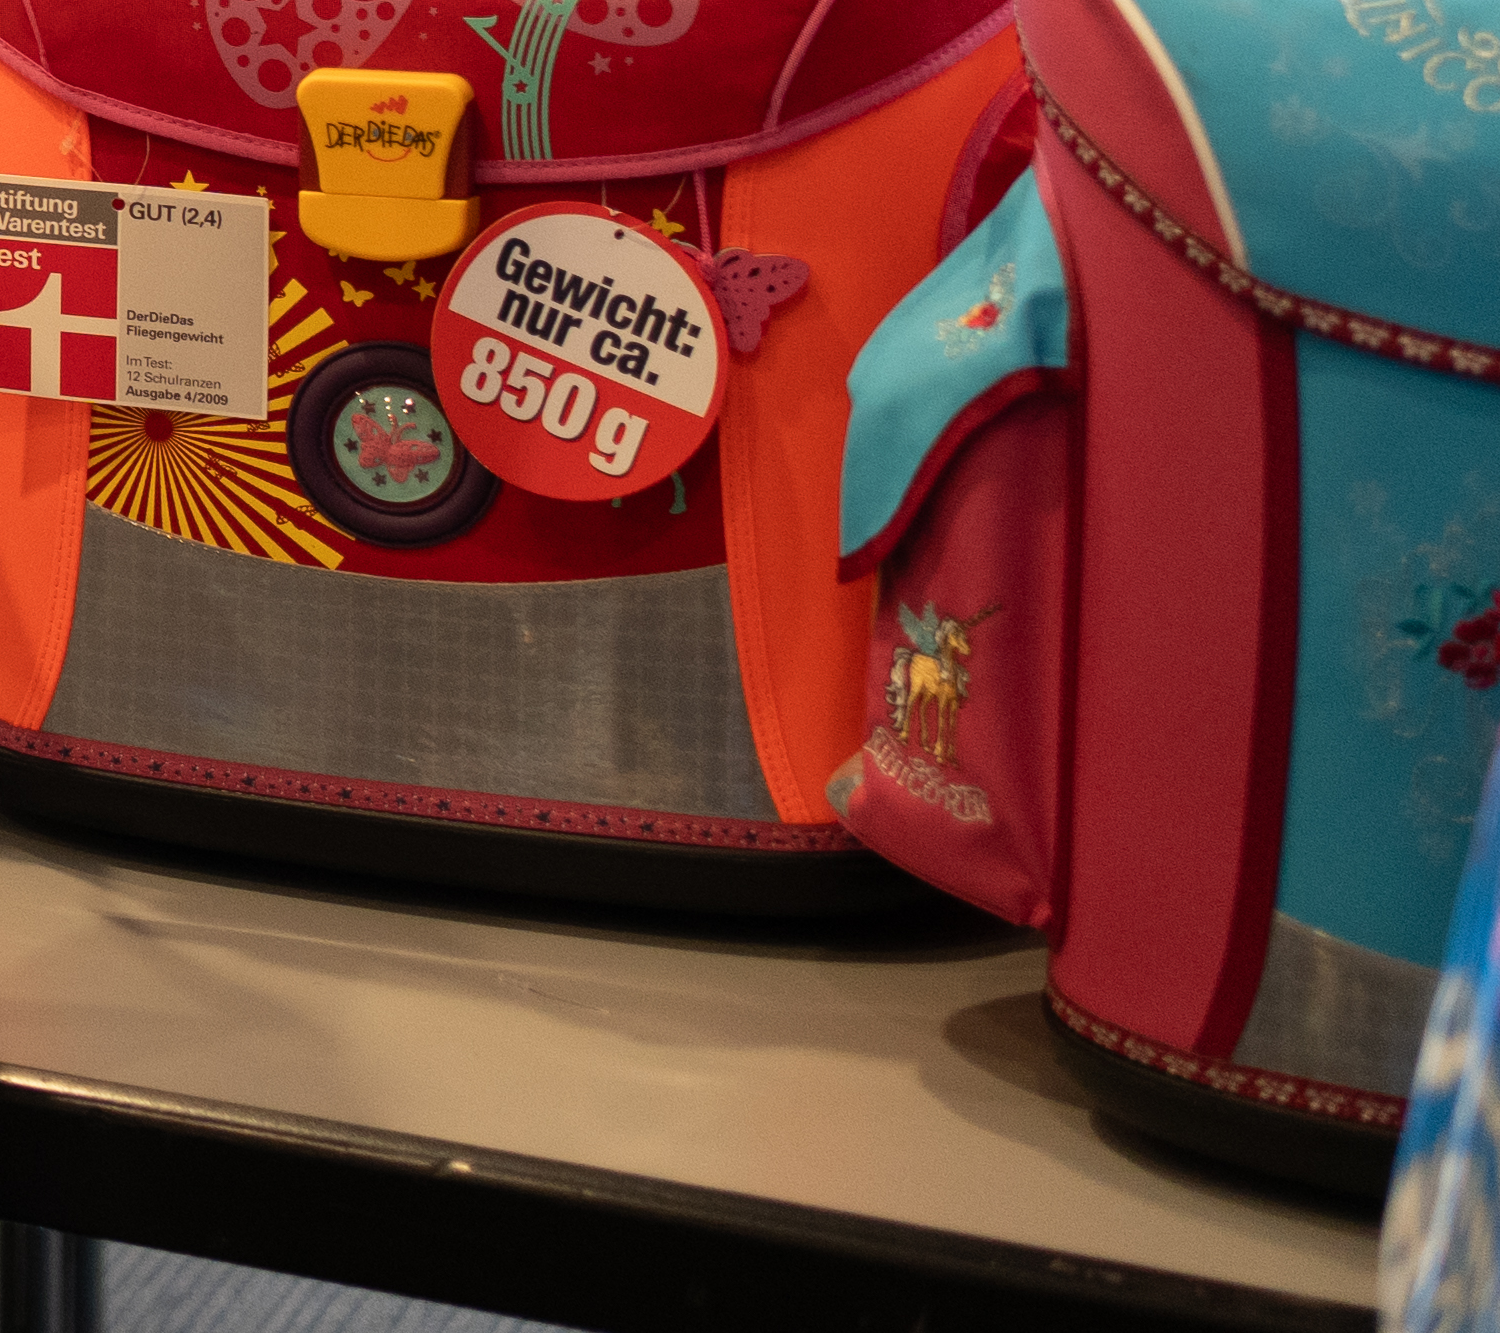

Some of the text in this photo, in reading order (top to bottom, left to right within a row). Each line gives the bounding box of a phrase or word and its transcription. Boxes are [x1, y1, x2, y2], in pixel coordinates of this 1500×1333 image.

[129, 201, 223, 230] GUT (2,4)
[495, 237, 702, 359] Gewicht:
[126, 309, 195, 328] DerDieDas
[126, 324, 225, 346] Fliegengewicht
[497, 288, 660, 387] nur ca.
[126, 355, 173, 370] Im Test:
[126, 370, 222, 390] 12 Schulranzen
[125, 385, 229, 406] Ausgabe 4/2009
[460, 336, 650, 476] 850 g
